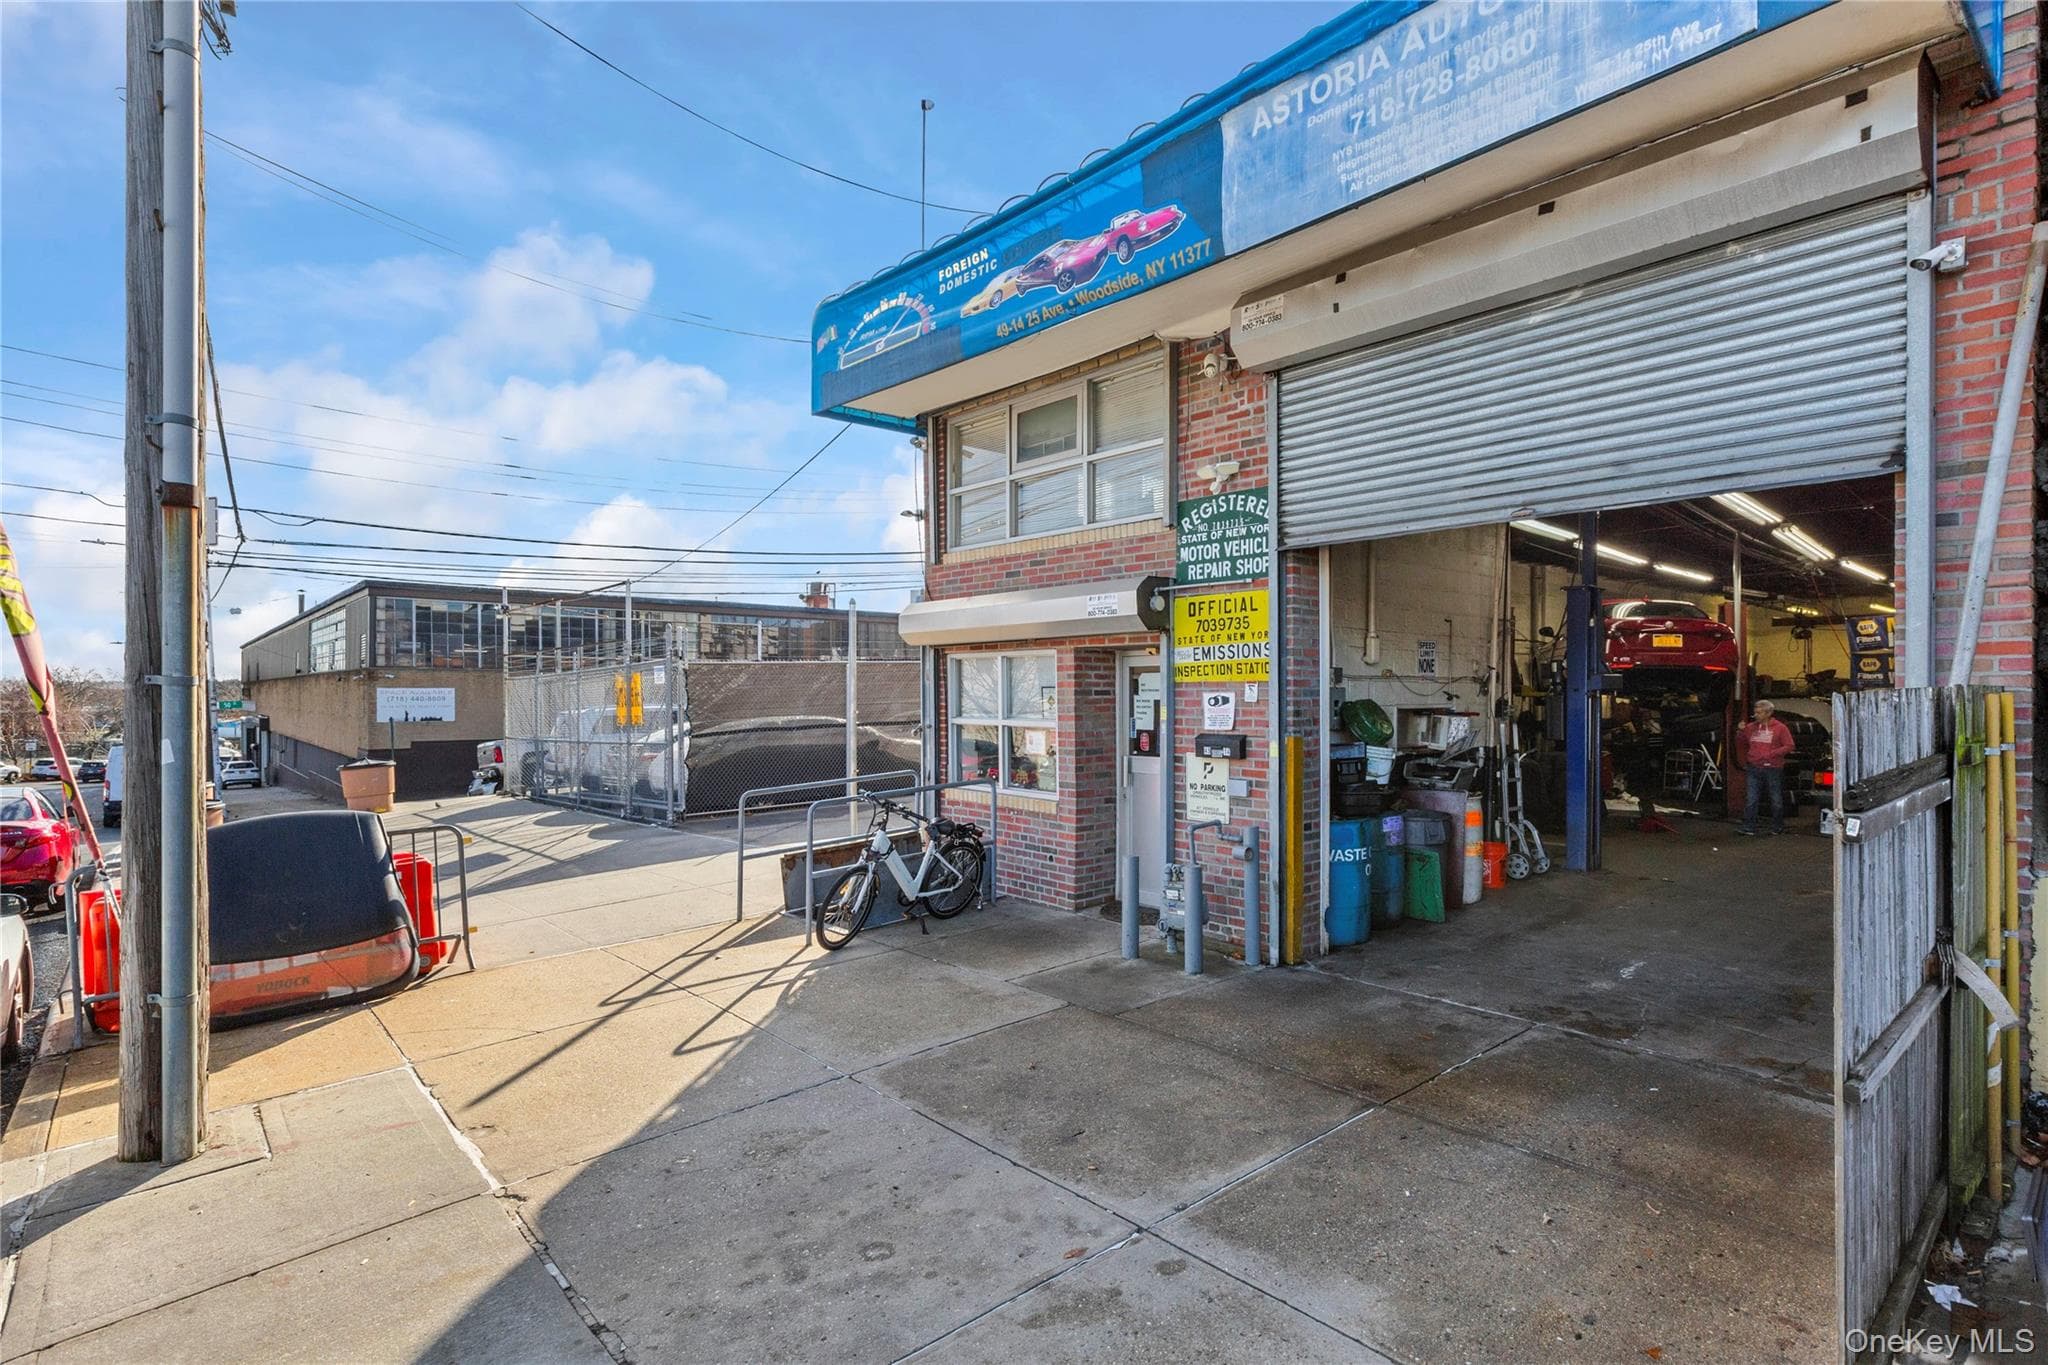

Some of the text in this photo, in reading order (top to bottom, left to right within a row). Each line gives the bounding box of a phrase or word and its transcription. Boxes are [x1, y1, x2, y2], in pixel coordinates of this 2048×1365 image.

[1671, 20, 1700, 43] Ave
[1307, 93, 1364, 128] Domestic
[1368, 76, 1392, 98] and
[1397, 49, 1450, 88] Foreign
[1454, 21, 1510, 56] service
[1514, 3, 1544, 31] and
[1652, 44, 1673, 66] NY
[1252, 44, 1391, 137] ASTORIA
[1350, 28, 1536, 135] 718-728-8060
[1349, 180, 1364, 193] Air
[938, 247, 989, 282] FOREIGN
[939, 259, 998, 295] DOMESTIC
[996, 317, 1025, 338] 49-14
[1026, 312, 1041, 328] 25
[1075, 273, 1144, 306] Woodside,
[1145, 256, 1166, 280] NY
[1169, 238, 1212, 270] 11377
[1181, 532, 1208, 545] STATE
[1210, 530, 1223, 540] OF
[1226, 526, 1247, 538] NEW
[1250, 523, 1269, 534] YOR
[1180, 536, 1269, 562] MOTOR VEHICL
[1188, 556, 1269, 580] REPAIR SHOP
[1188, 596, 1258, 618] OFFICIAL
[1196, 616, 1250, 633] 7039735
[1177, 630, 1269, 646] STATE OF NEW YOR
[1419, 641, 1436, 649] SPEED
[1175, 662, 1269, 677] INSPECTION STATIO
[1419, 659, 1435, 673] NONE
[1189, 782, 1226, 793] NO PARKING
